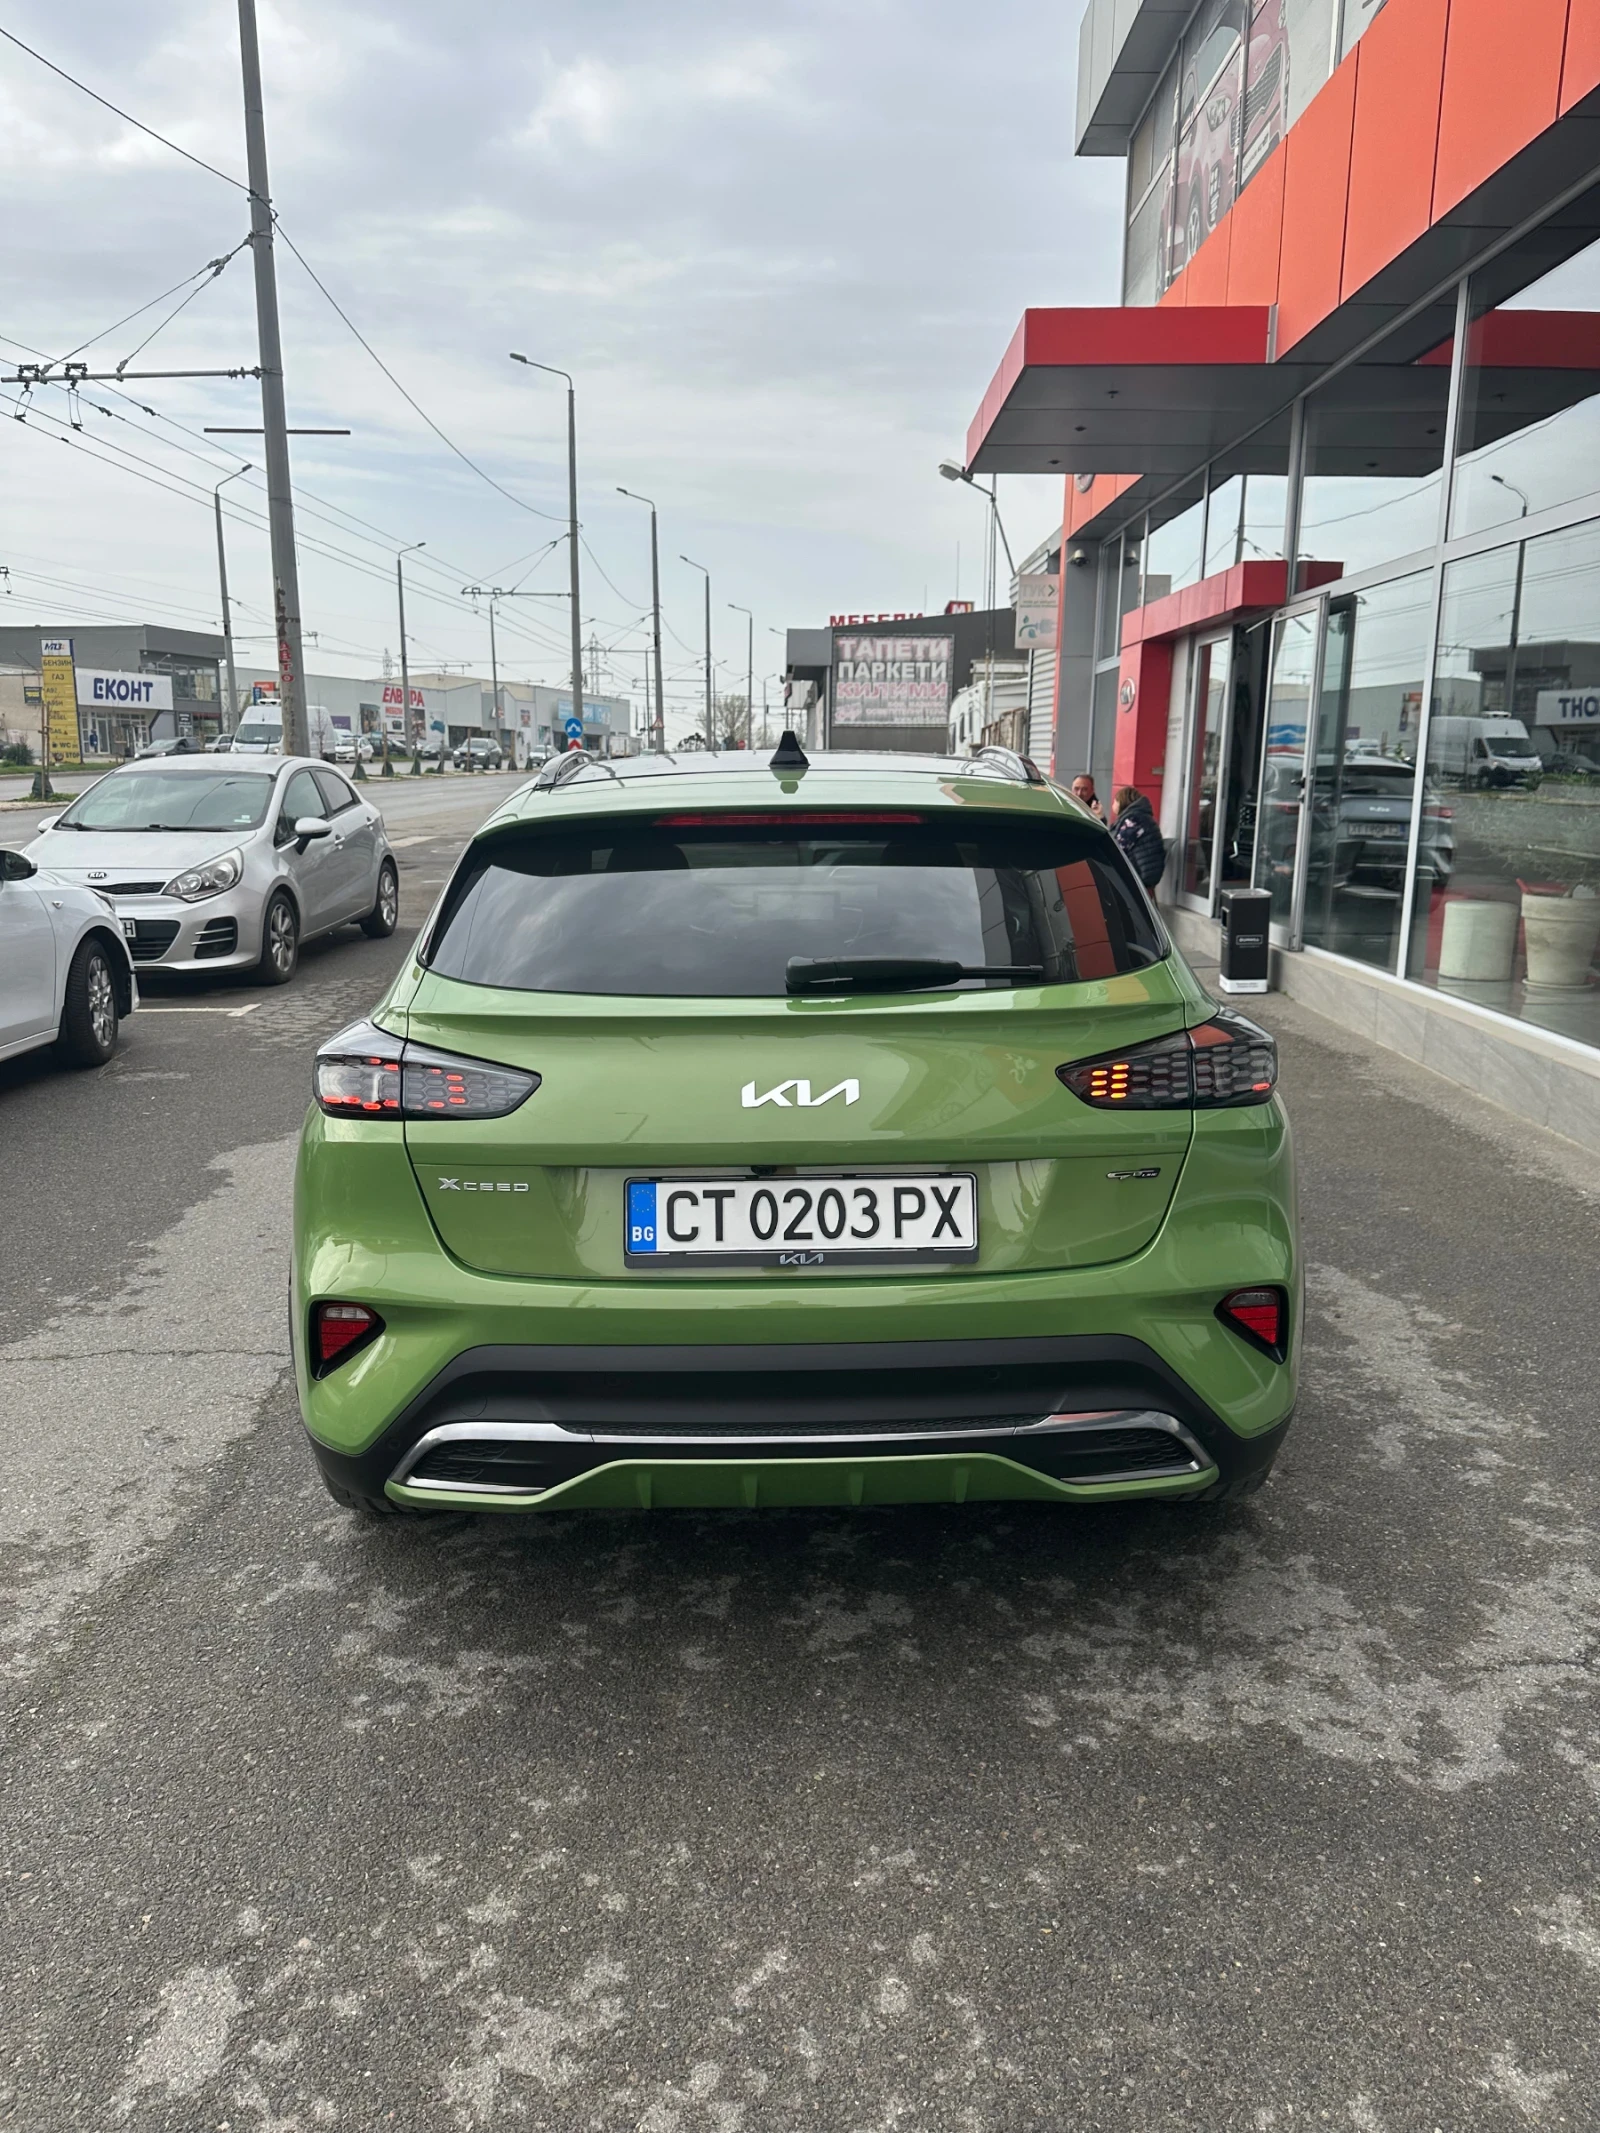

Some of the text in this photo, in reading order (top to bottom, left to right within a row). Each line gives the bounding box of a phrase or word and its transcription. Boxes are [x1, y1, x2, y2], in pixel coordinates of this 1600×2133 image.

[839, 638, 949, 660] ТАПЕТИ
[838, 661, 948, 680] ПАРКЕТИ
[93, 677, 153, 702] ЕКОНТ
[382, 686, 425, 707] ЕЛВРА
[837, 681, 948, 698] КИЛИМИ
[89, 871, 106, 879] KIA
[741, 1078, 860, 1108] KIA
[632, 1185, 963, 1242] BG CT 0203 PX
[779, 1251, 823, 1265] KIA
